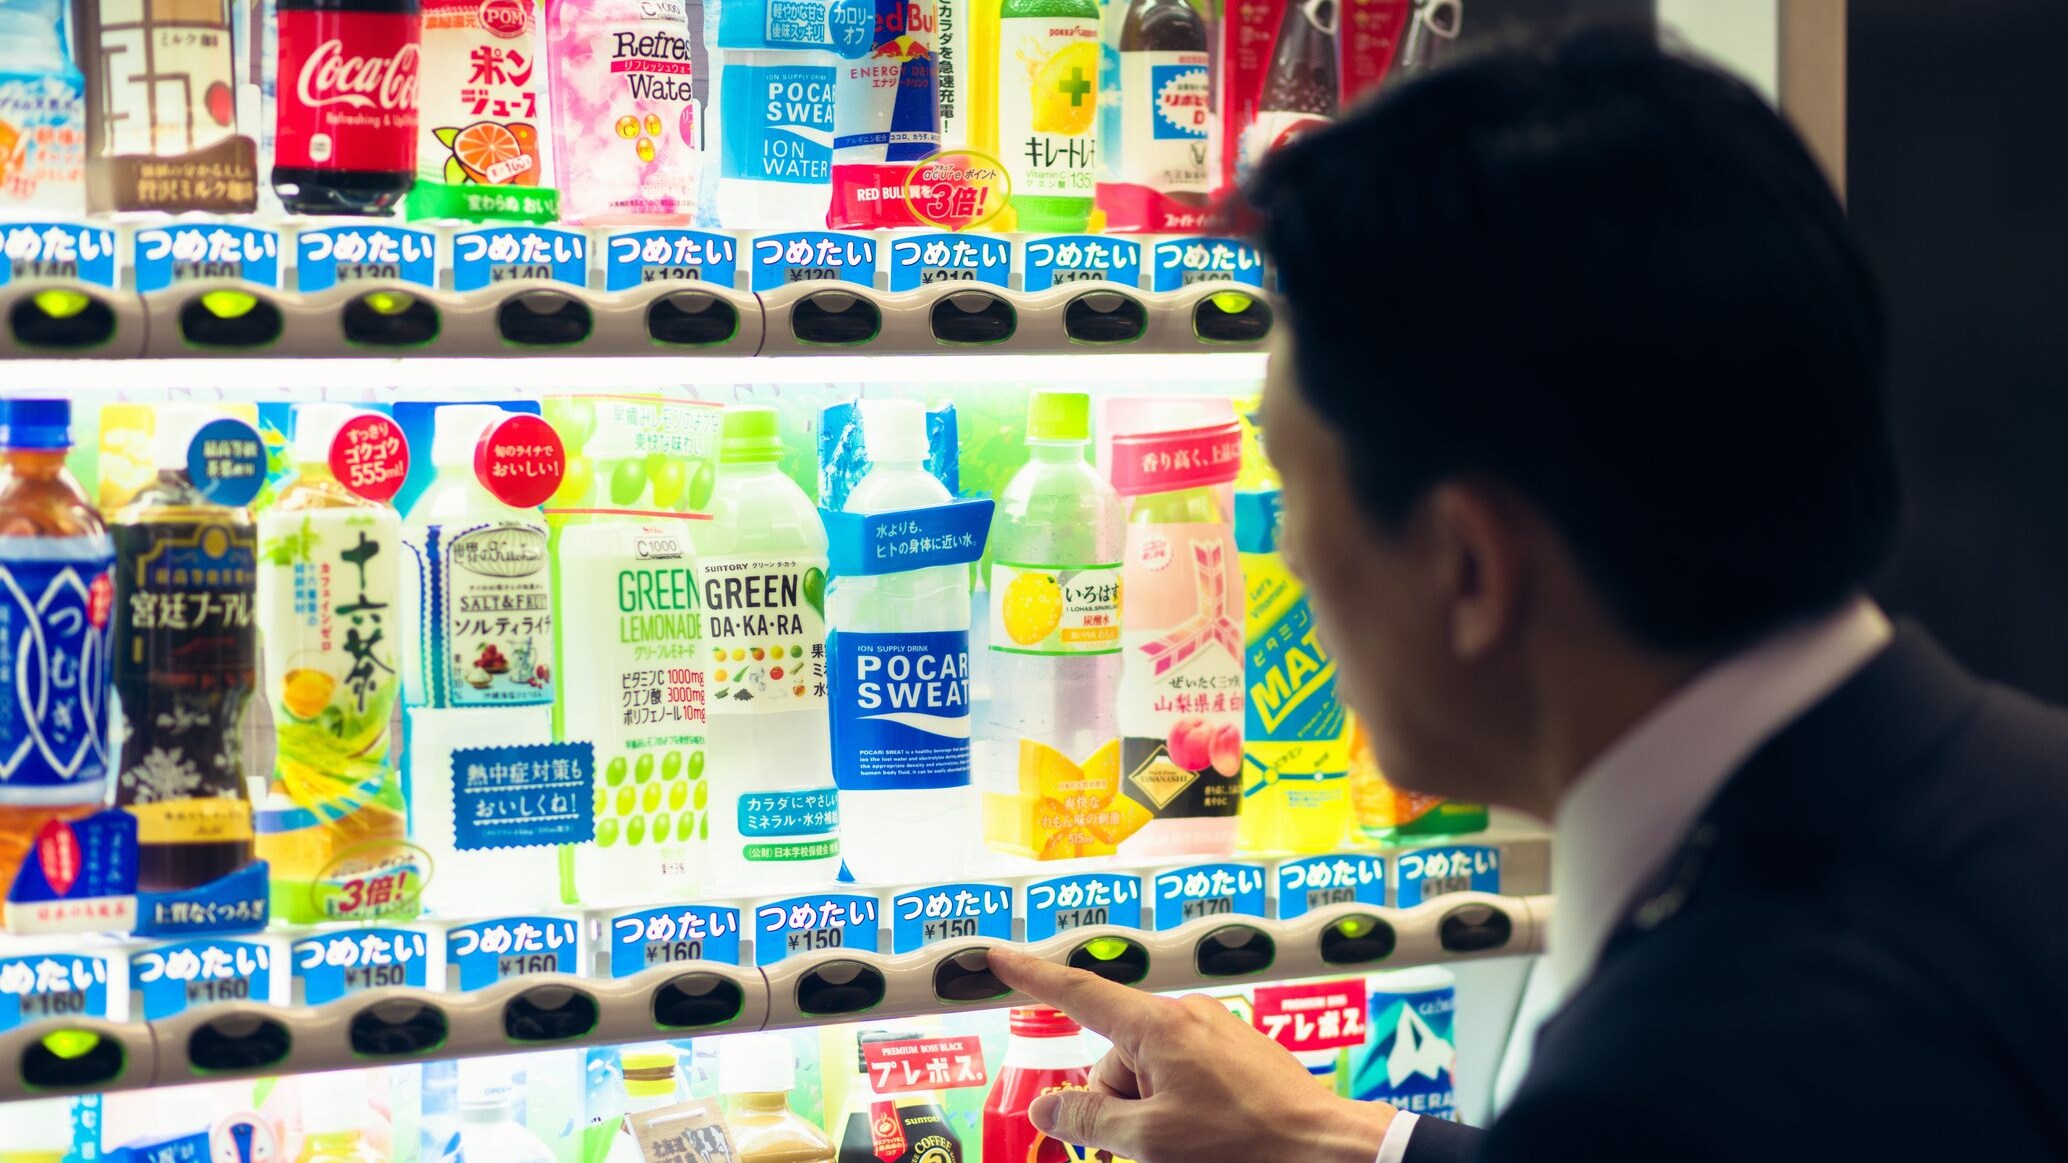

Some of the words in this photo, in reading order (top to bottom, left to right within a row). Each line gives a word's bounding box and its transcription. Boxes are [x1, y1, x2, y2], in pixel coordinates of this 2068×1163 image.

[486, 8, 523, 25] POM
[773, 3, 825, 21] 軽やかな甘さ
[834, 5, 873, 26] カロリー
[875, 2, 902, 32] ed
[772, 22, 825, 42] 後味スッキリ!
[844, 26, 865, 45] オフ
[467, 44, 534, 88] ポン
[766, 101, 835, 124] SWEA
[764, 139, 804, 159] ION
[763, 157, 829, 178] WATER
[965, 169, 997, 180] ポイント
[857, 187, 880, 202] RED
[927, 182, 988, 218] 3倍!
[138, 228, 277, 262] つめたい
[300, 231, 433, 262] つめたい
[456, 233, 584, 264] つめたい
[610, 235, 735, 266] つめたい
[755, 237, 873, 267] つめたい
[894, 240, 1008, 268] つめたい
[1028, 241, 1138, 269] つめたい
[1156, 240, 1262, 268] つめたい
[346, 422, 389, 444] すっきり
[344, 437, 400, 465] ゴクゴク
[494, 445, 554, 459] 旬のライチで
[492, 460, 560, 478] おいしい!
[876, 520, 923, 539] 水よりも、
[876, 532, 978, 559] ヒトの身体に近い水。
[705, 574, 798, 611] GREEN
[335, 530, 396, 712] 十六茶
[620, 613, 703, 643] LEMONADE
[811, 643, 827, 659] 果
[877, 645, 905, 653] SUPPLY
[667, 668, 705, 688] 1000mg
[622, 687, 663, 708] クエン酸
[667, 687, 706, 706] 3000mg
[857, 680, 969, 710] SWEAT
[623, 706, 682, 727] ポリフェノール
[683, 705, 707, 724] 10mg
[467, 758, 583, 787] 熱中症対策も
[475, 792, 577, 818] おいしくね!
[1281, 858, 1383, 889] つめたい
[1399, 850, 1498, 880] つめたい
[338, 870, 408, 914] 3倍!
[1030, 879, 1139, 909] つめたい
[1157, 869, 1264, 899] つめたい
[155, 900, 266, 924] 上質なくつろぎ
[759, 900, 876, 932] つめたい
[897, 889, 1009, 920] つめたい
[1183, 897, 1231, 920] ¥170
[615, 911, 737, 944] つめたい
[924, 919, 977, 940] ¥150
[1057, 908, 1108, 929] ¥140
[294, 934, 426, 969] つめたい
[449, 922, 576, 956] つめたい
[646, 940, 702, 963] ¥160
[788, 928, 843, 951] ¥150
[130, 946, 270, 983] つめたい
[345, 965, 406, 988] ¥150
[500, 955, 557, 976] ¥160
[186, 978, 249, 1002] ¥160
[881, 1044, 918, 1056] PREMIUM
[920, 1043, 940, 1055] BOSS
[940, 1041, 964, 1053] BLACK
